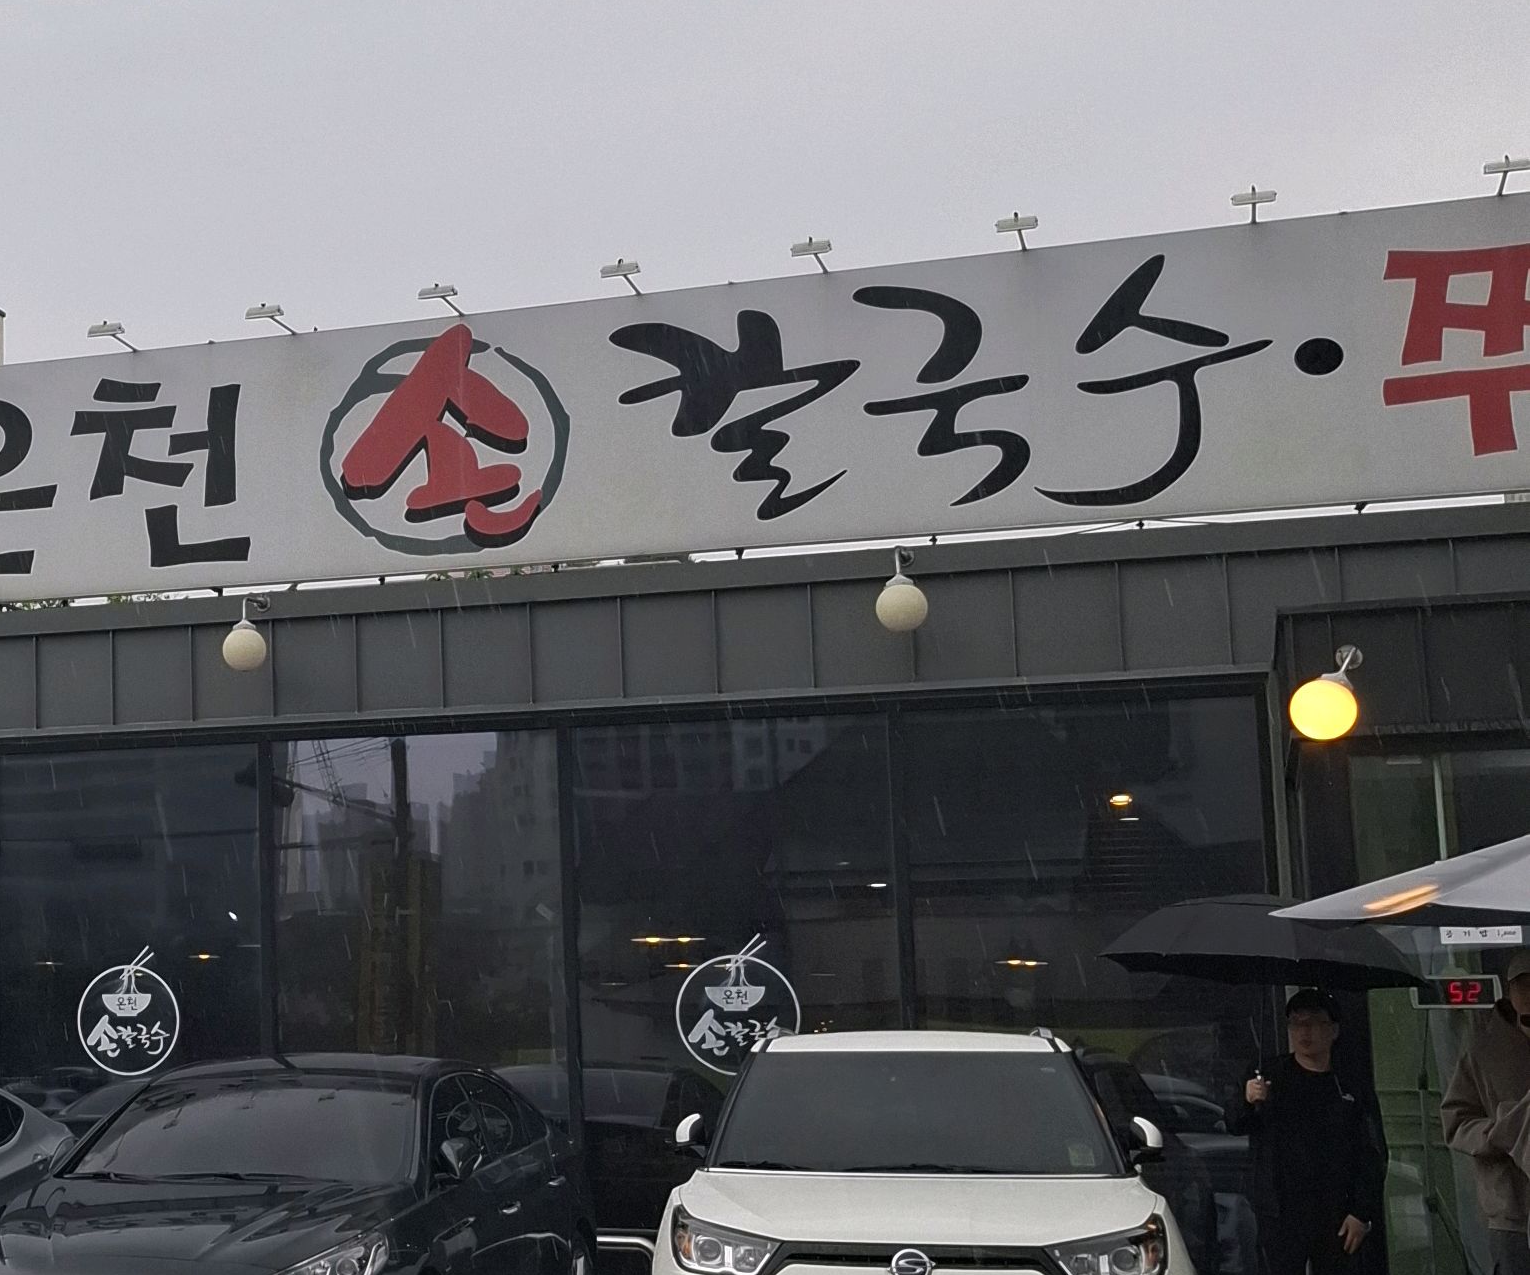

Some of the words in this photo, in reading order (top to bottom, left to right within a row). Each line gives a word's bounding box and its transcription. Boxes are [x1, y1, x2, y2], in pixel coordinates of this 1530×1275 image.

[722, 989, 749, 1005] 온천
[1448, 981, 1482, 1003] 52
[115, 996, 139, 1011] 온천
[86, 1014, 171, 1058] 손칼국수
